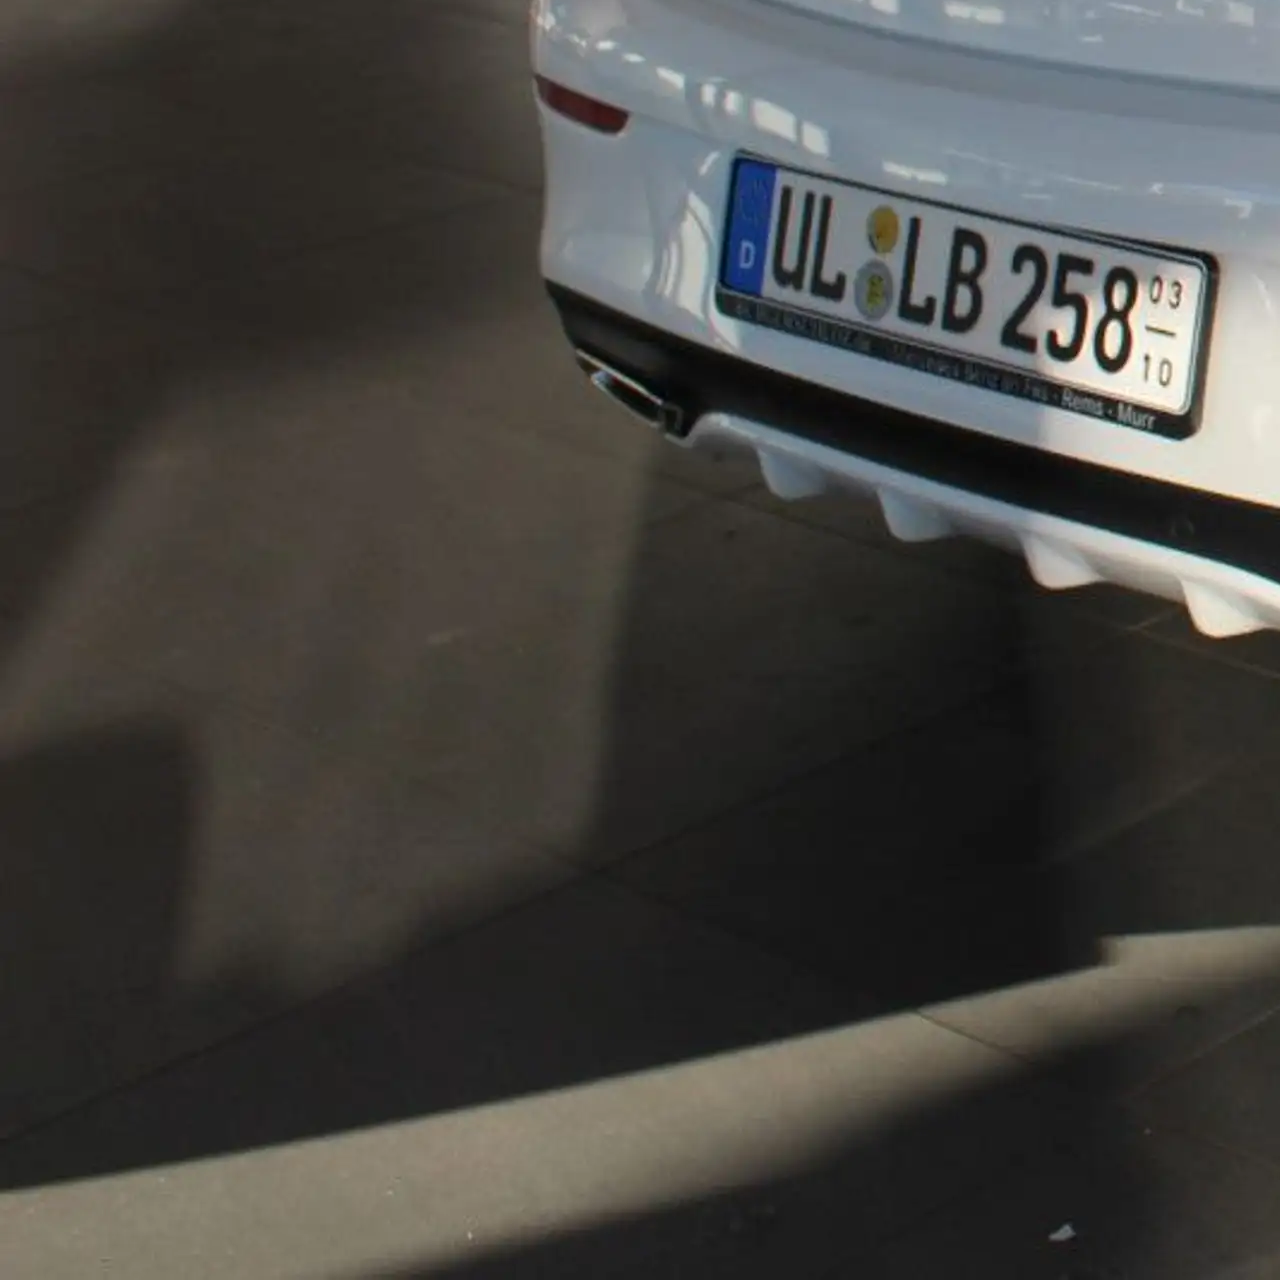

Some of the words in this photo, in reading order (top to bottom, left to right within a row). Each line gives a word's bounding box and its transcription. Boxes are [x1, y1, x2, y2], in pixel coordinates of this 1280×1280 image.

[738, 240, 755, 269] D
[771, 186, 846, 302] UL
[898, 217, 988, 333] LB
[999, 243, 1140, 374] 258
[1148, 275, 1182, 309] 03
[1141, 354, 1173, 387] 10
[1117, 403, 1156, 429] Murr
